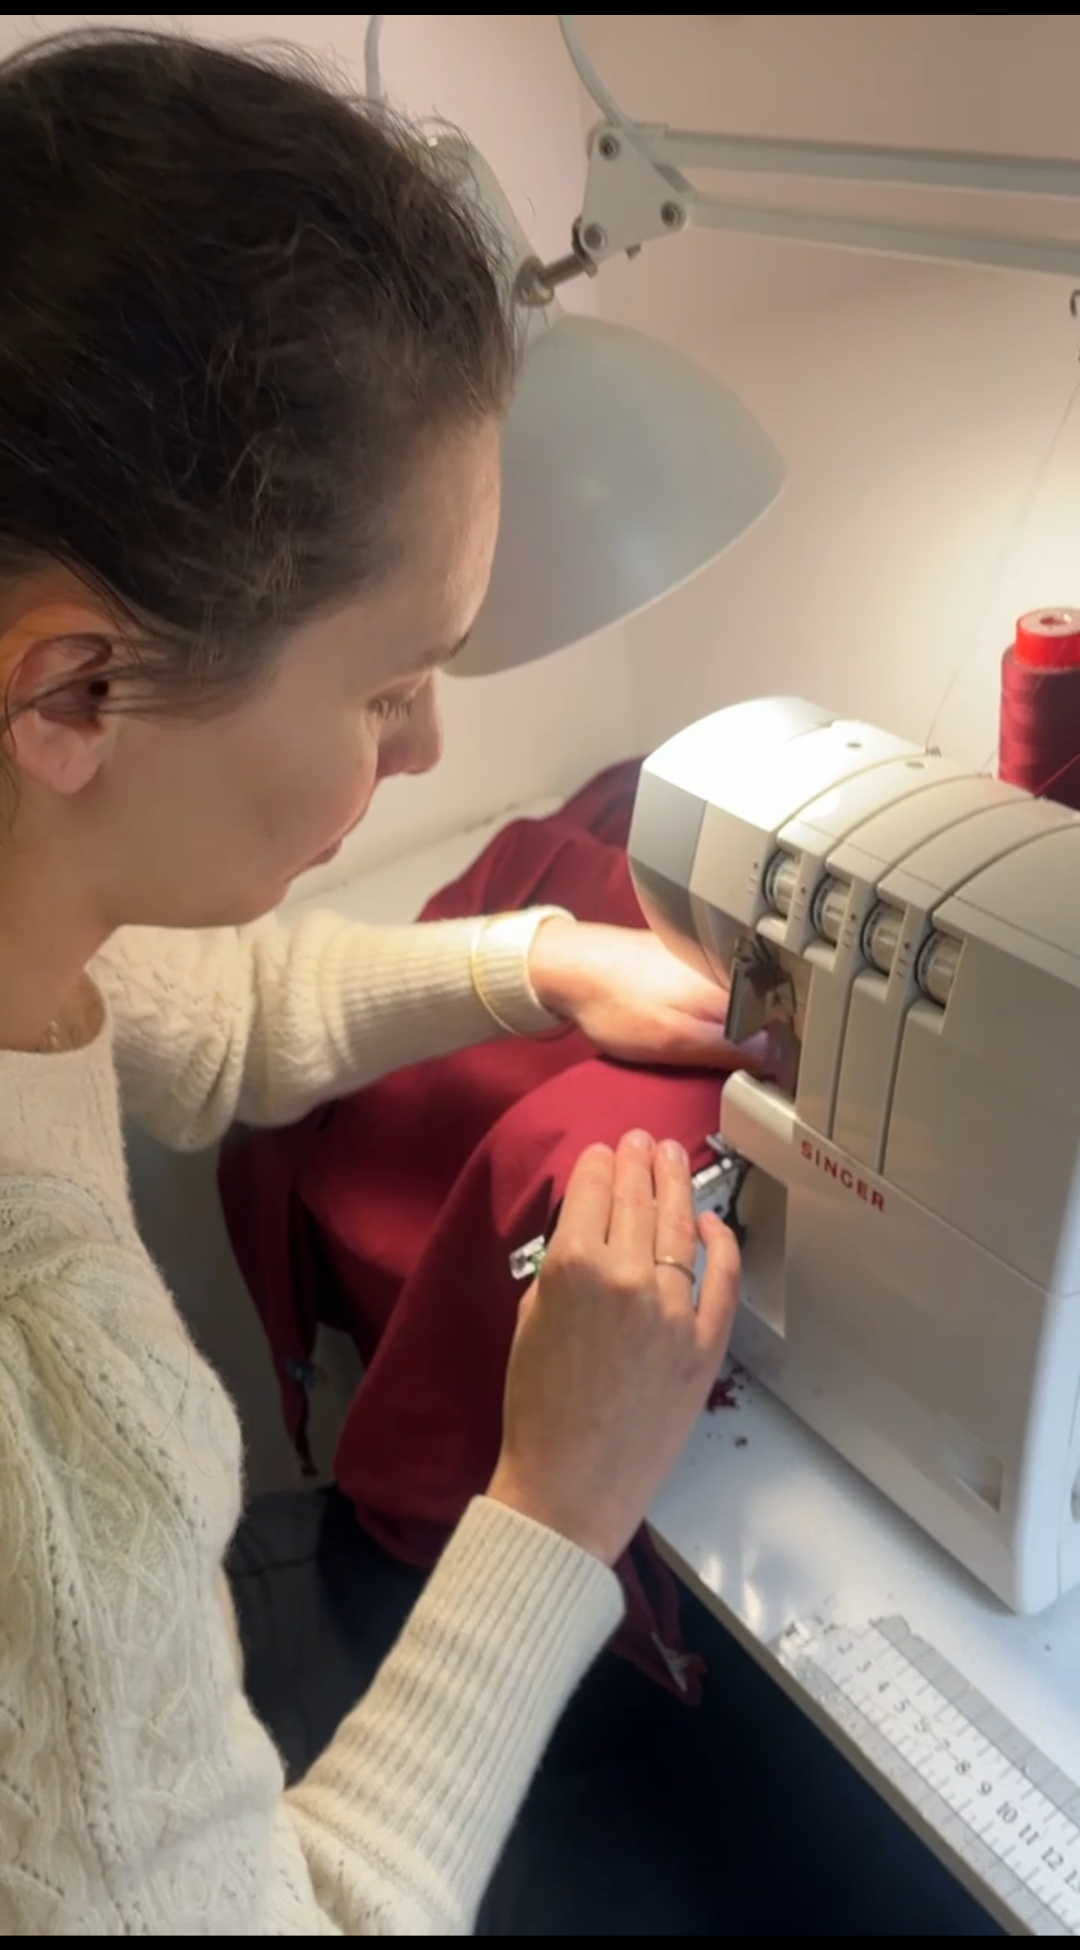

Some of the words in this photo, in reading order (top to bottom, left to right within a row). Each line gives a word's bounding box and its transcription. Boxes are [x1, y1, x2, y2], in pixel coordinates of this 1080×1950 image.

[801, 1140, 885, 1212] SINGER
[955, 1760, 971, 1776] 8
[976, 1780, 993, 1796] 9
[996, 1801, 1018, 1824] 10
[1018, 1823, 1039, 1846] 11
[1041, 1846, 1064, 1872] 12
